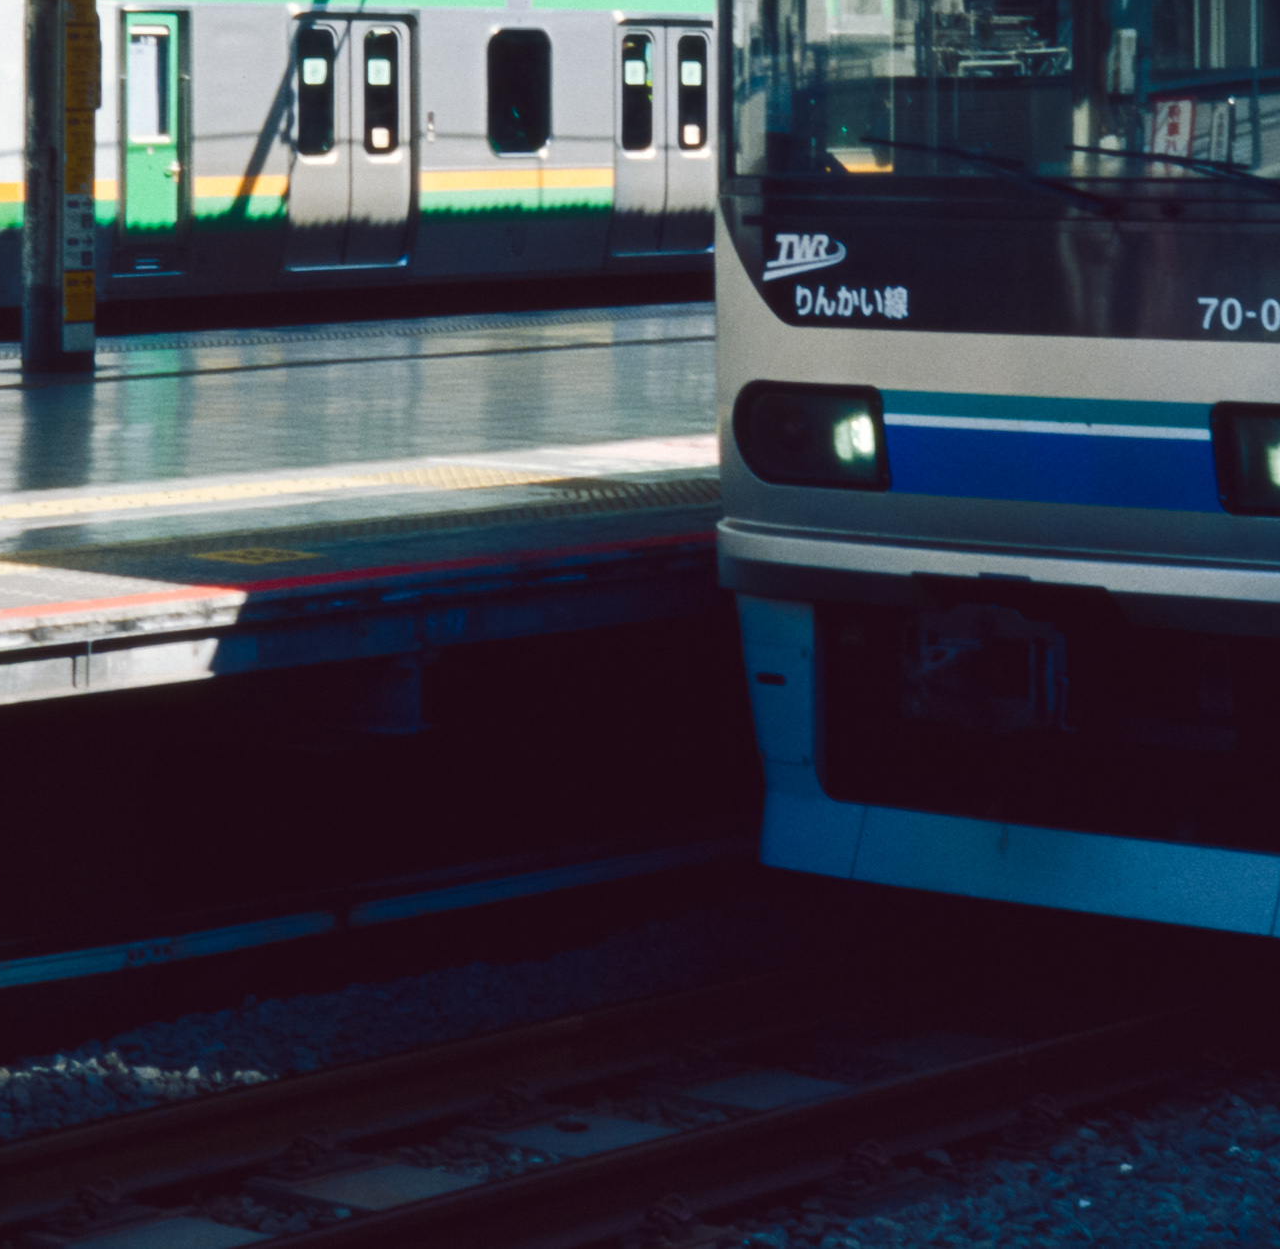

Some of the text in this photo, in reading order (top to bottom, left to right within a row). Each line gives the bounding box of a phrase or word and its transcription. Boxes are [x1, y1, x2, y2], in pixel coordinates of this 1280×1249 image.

[774, 233, 830, 262] TWR
[795, 284, 910, 320] りんかい線
